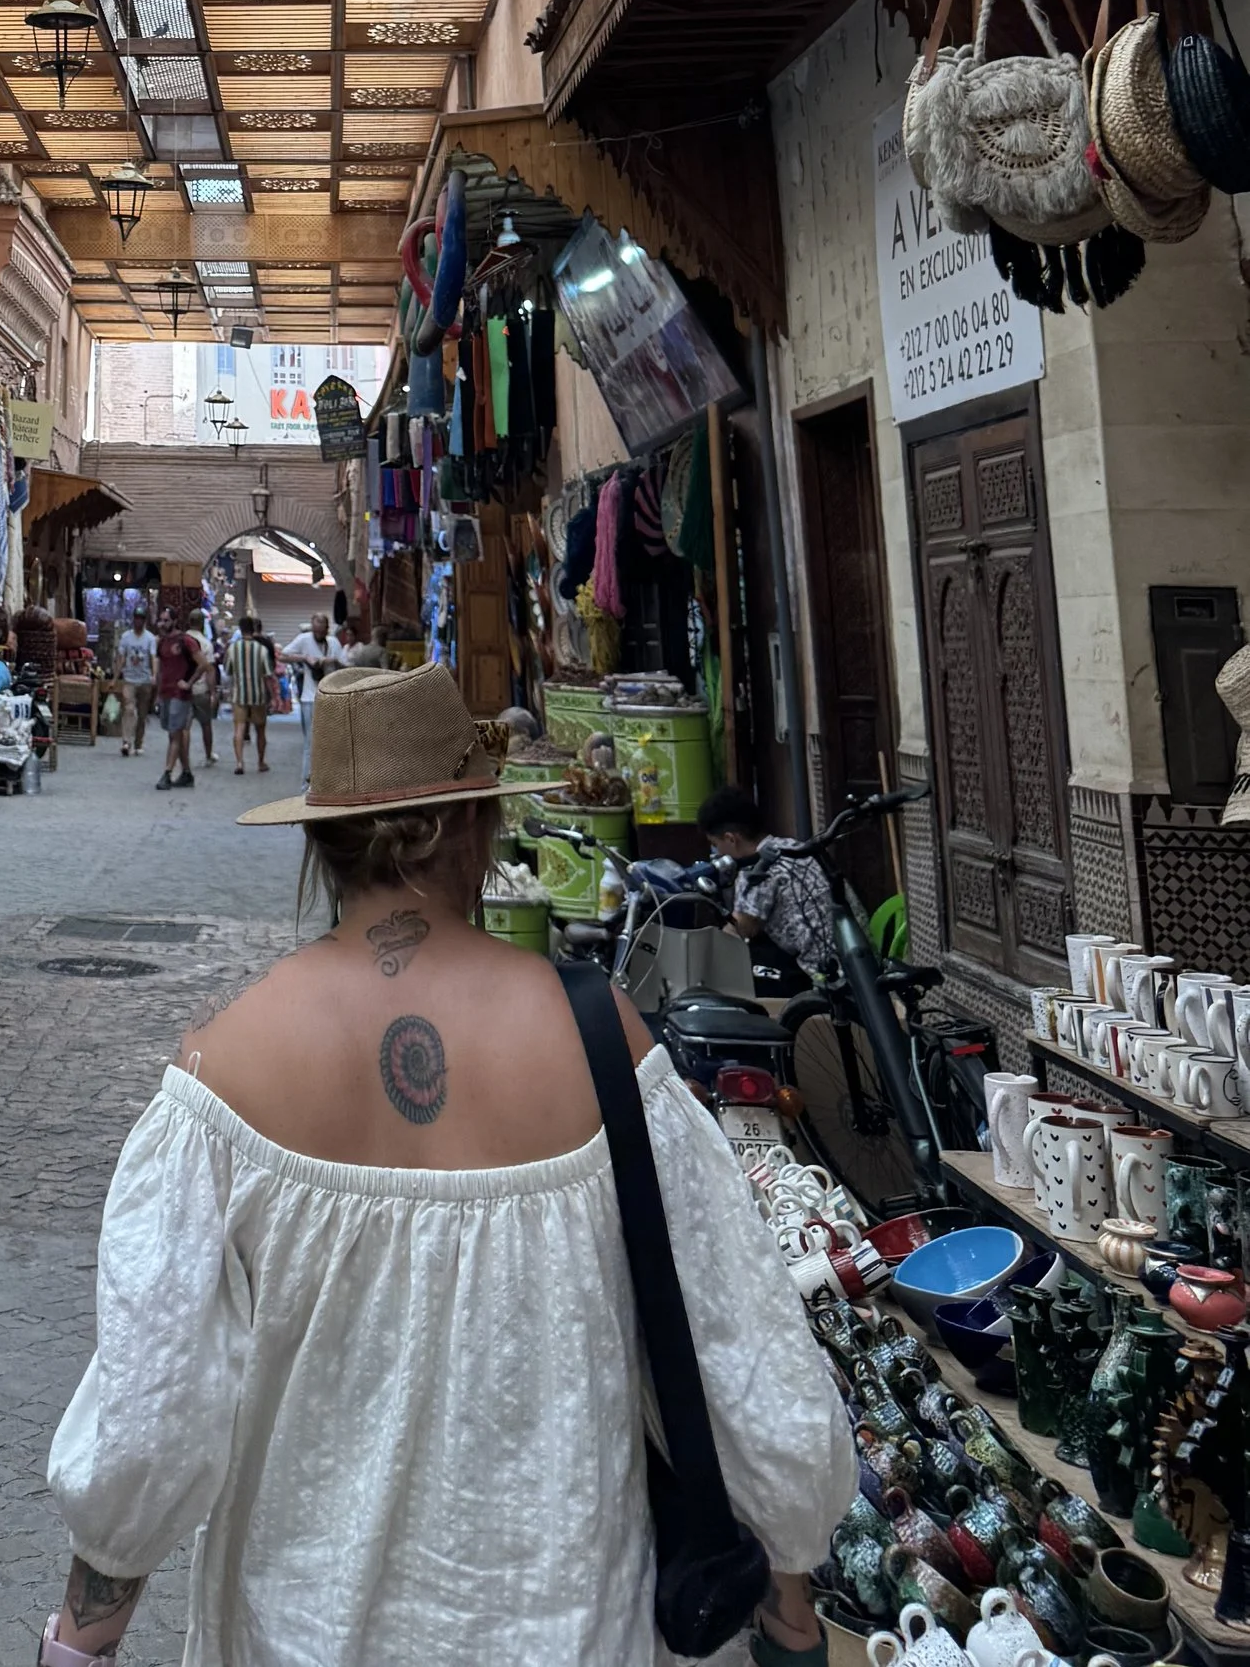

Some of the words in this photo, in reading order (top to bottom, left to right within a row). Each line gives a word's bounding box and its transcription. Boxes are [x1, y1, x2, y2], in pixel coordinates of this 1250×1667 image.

[892, 198, 907, 259] A
[899, 265, 915, 300] EN
[899, 324, 923, 362] +212
[923, 322, 930, 352] 7
[934, 314, 950, 349] 00
[953, 306, 968, 341] 06
[971, 297, 988, 334] 04
[991, 289, 1010, 326] 80
[903, 364, 927, 399] +212
[929, 361, 936, 392] 5
[938, 354, 954, 389] 24
[958, 347, 973, 381] 42
[975, 340, 993, 376] 22
[996, 332, 1013, 369] 29
[13, 414, 40, 425] Bazard
[743, 1122, 760, 1136] 26
